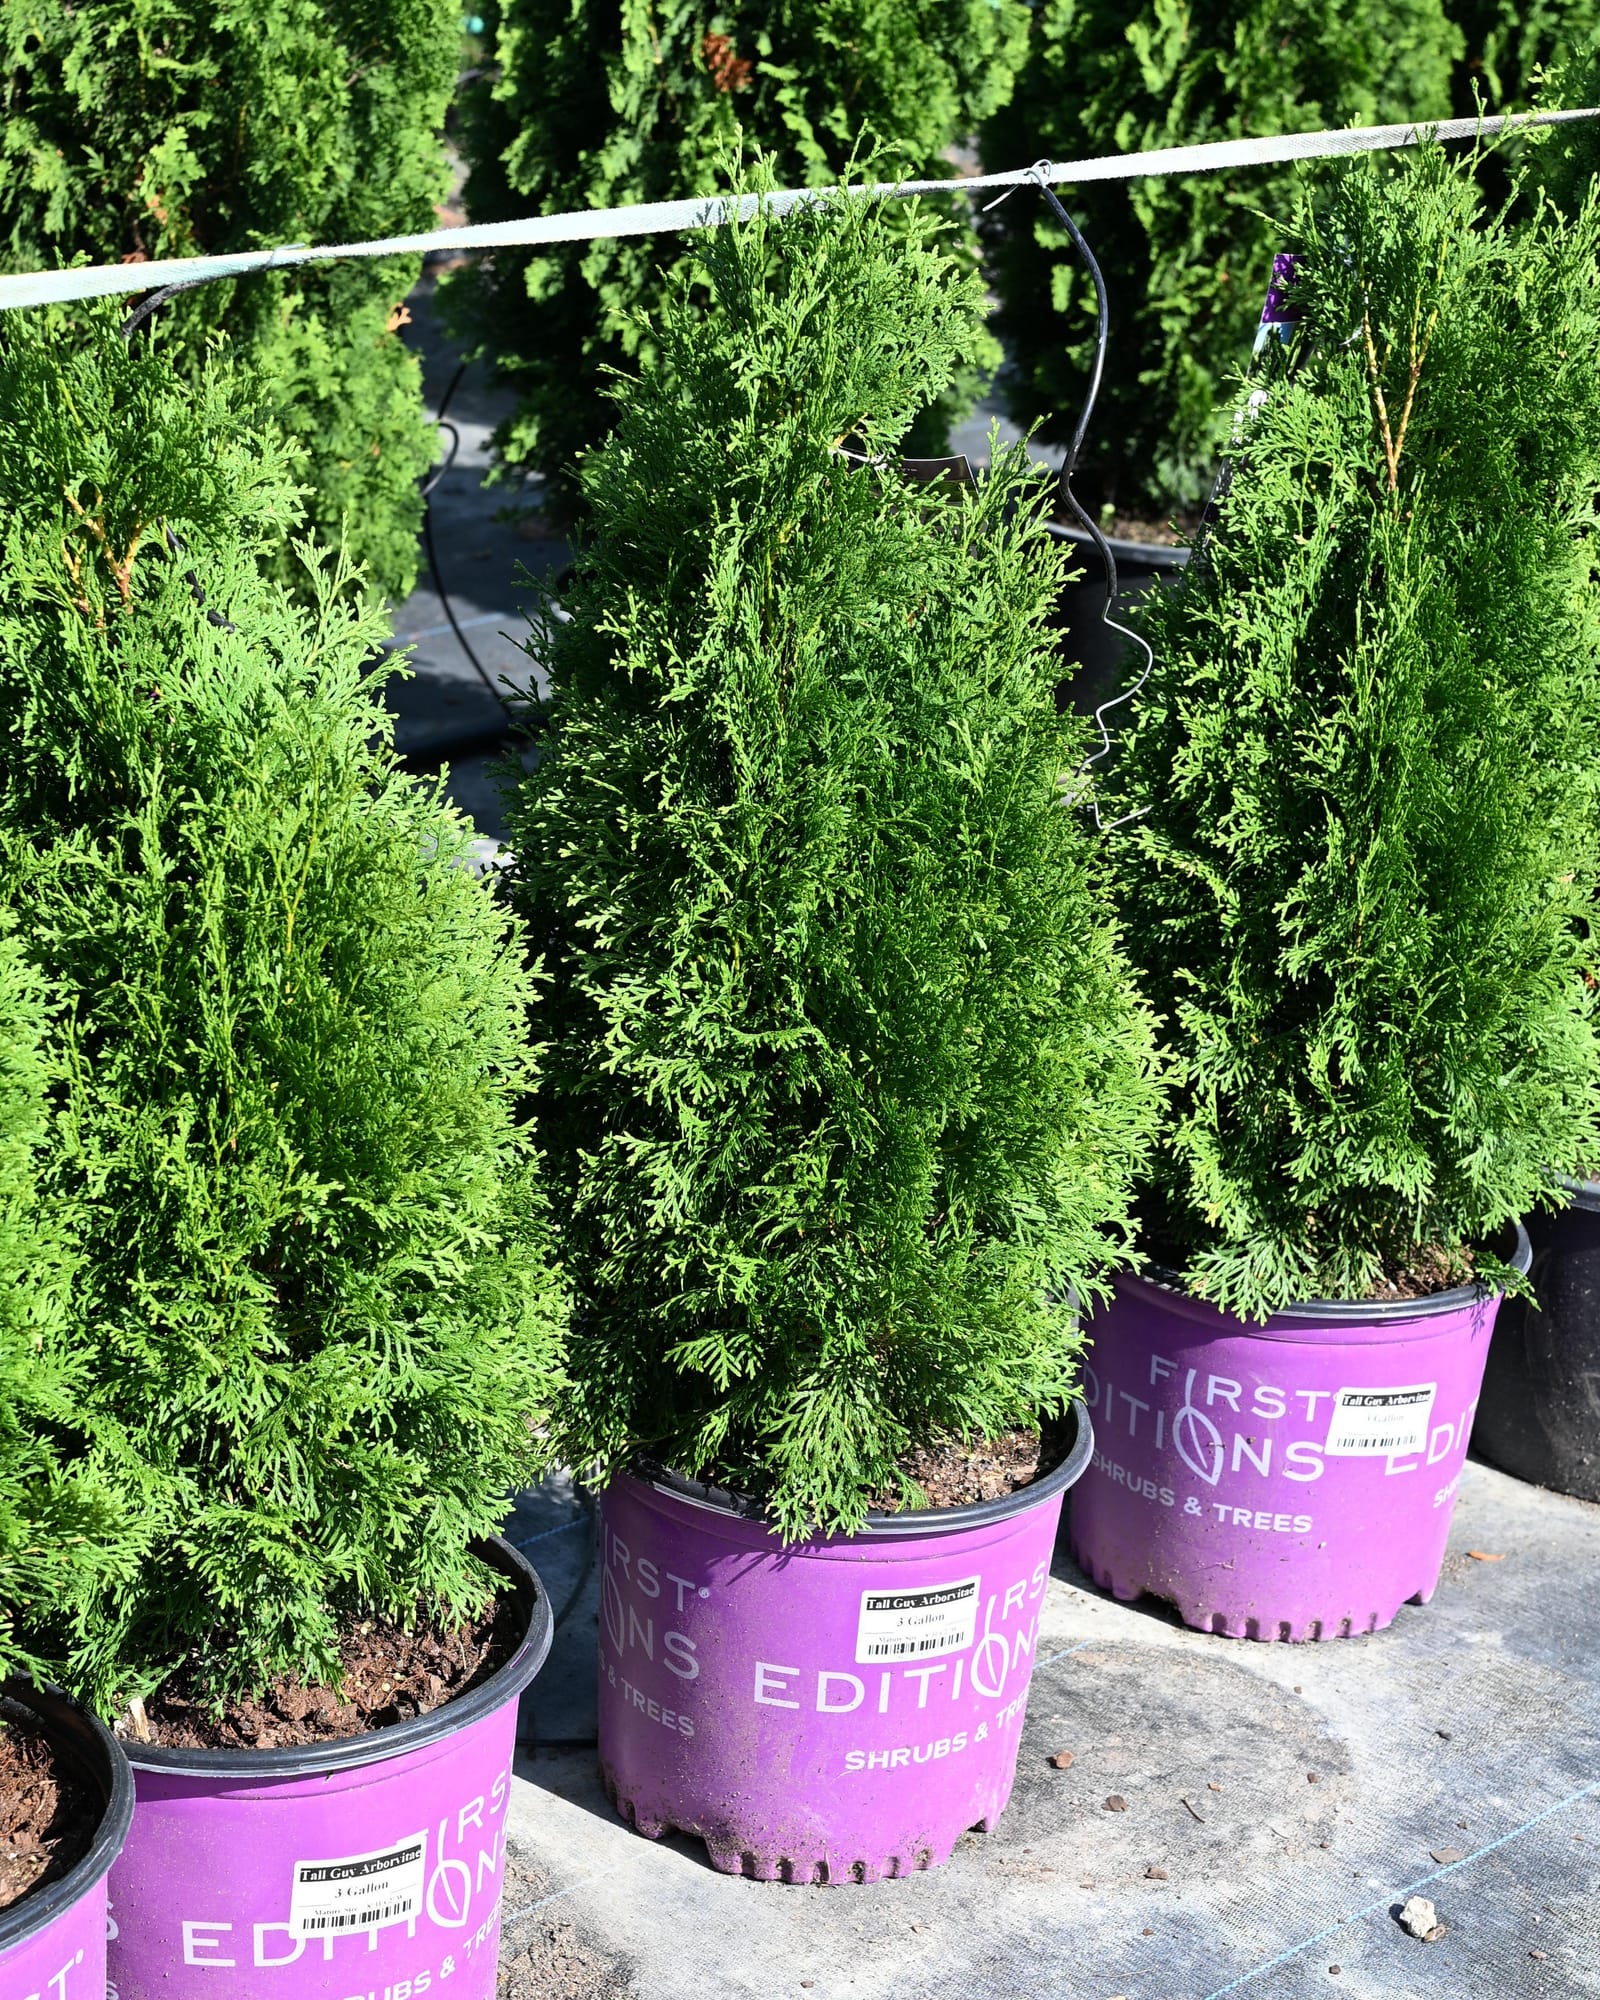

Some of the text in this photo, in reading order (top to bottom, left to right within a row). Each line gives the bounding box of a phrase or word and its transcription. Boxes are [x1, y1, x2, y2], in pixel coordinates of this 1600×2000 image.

[1343, 1395, 1362, 1406] Tall
[1364, 1396, 1383, 1407] Guy
[1083, 1362, 1326, 1487] DITIONS
[1183, 1496, 1203, 1517] &
[1213, 1502, 1313, 1534] TREES
[868, 1586, 975, 1610] Tall Guy Arborvitae
[896, 1613, 945, 1628] 3 Gallon
[620, 1676, 695, 1738] TREES
[844, 1731, 968, 1771] SHRUBS
[974, 1721, 989, 1743] &
[301, 1849, 421, 1882] Tall Guy Arborvitae
[334, 1881, 389, 1899] 3 Gallon
[439, 1954, 456, 1980] &
